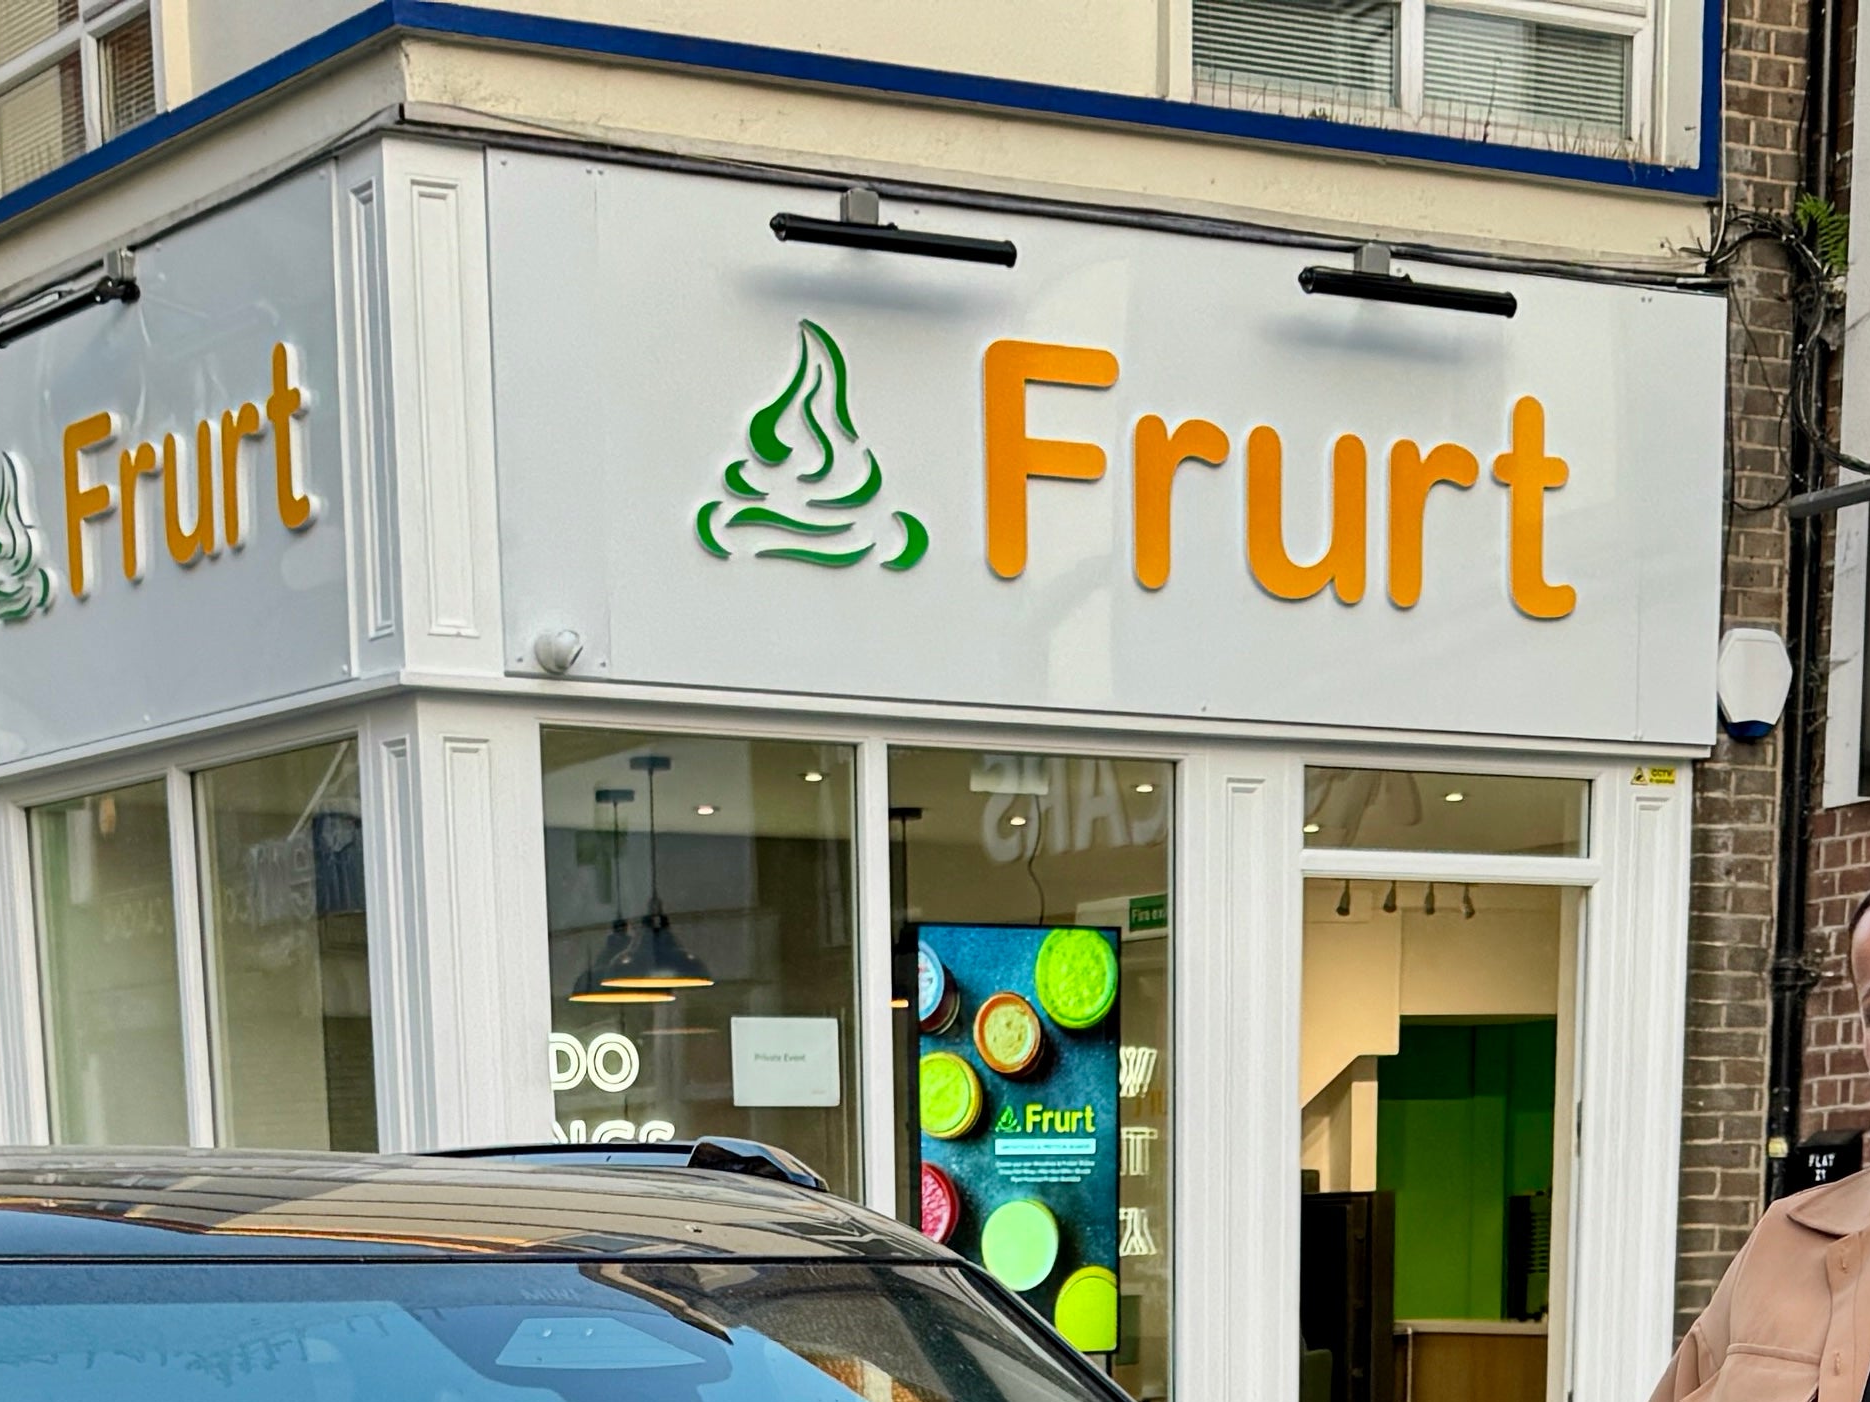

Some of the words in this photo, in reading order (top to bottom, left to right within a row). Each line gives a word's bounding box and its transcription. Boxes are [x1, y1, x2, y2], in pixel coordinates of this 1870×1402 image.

[63, 341, 311, 597] Frurt
[983, 340, 1577, 619] Frurt
[783, 1053, 806, 1063] Event
[1025, 1104, 1096, 1133] Frurt
[1808, 1152, 1835, 1168] FLAT
